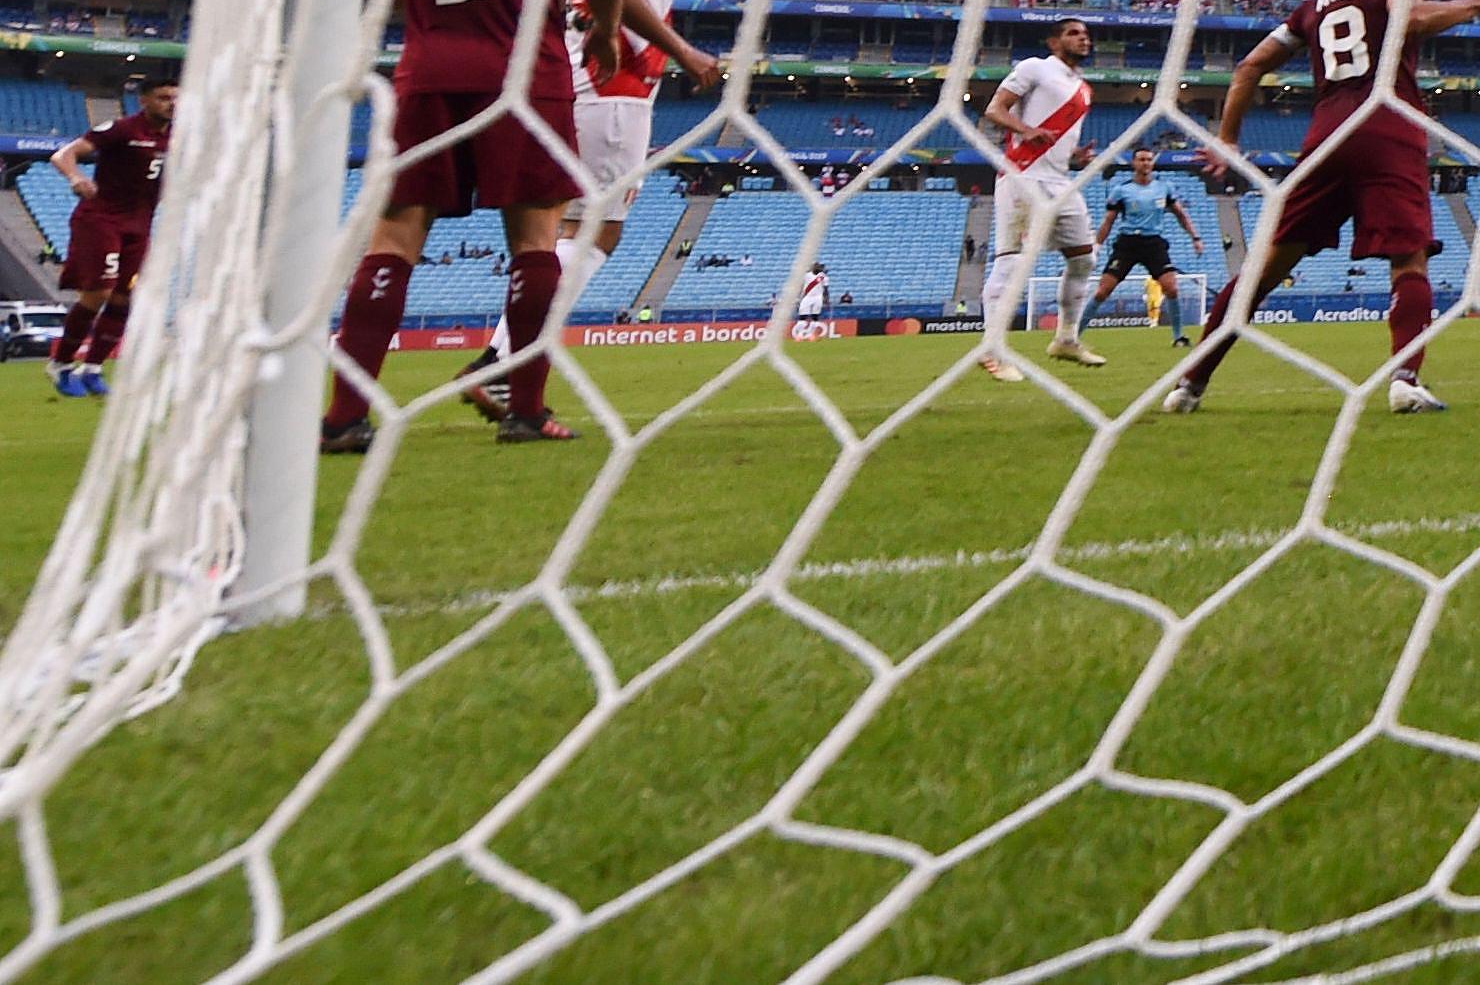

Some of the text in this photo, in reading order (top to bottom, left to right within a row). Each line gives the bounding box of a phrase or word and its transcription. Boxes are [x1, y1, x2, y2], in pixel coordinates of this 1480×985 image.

[1319, 4, 1370, 82] 8
[147, 159, 163, 180] 5
[105, 253, 120, 273] 5
[584, 323, 768, 345] Internet a bordo
